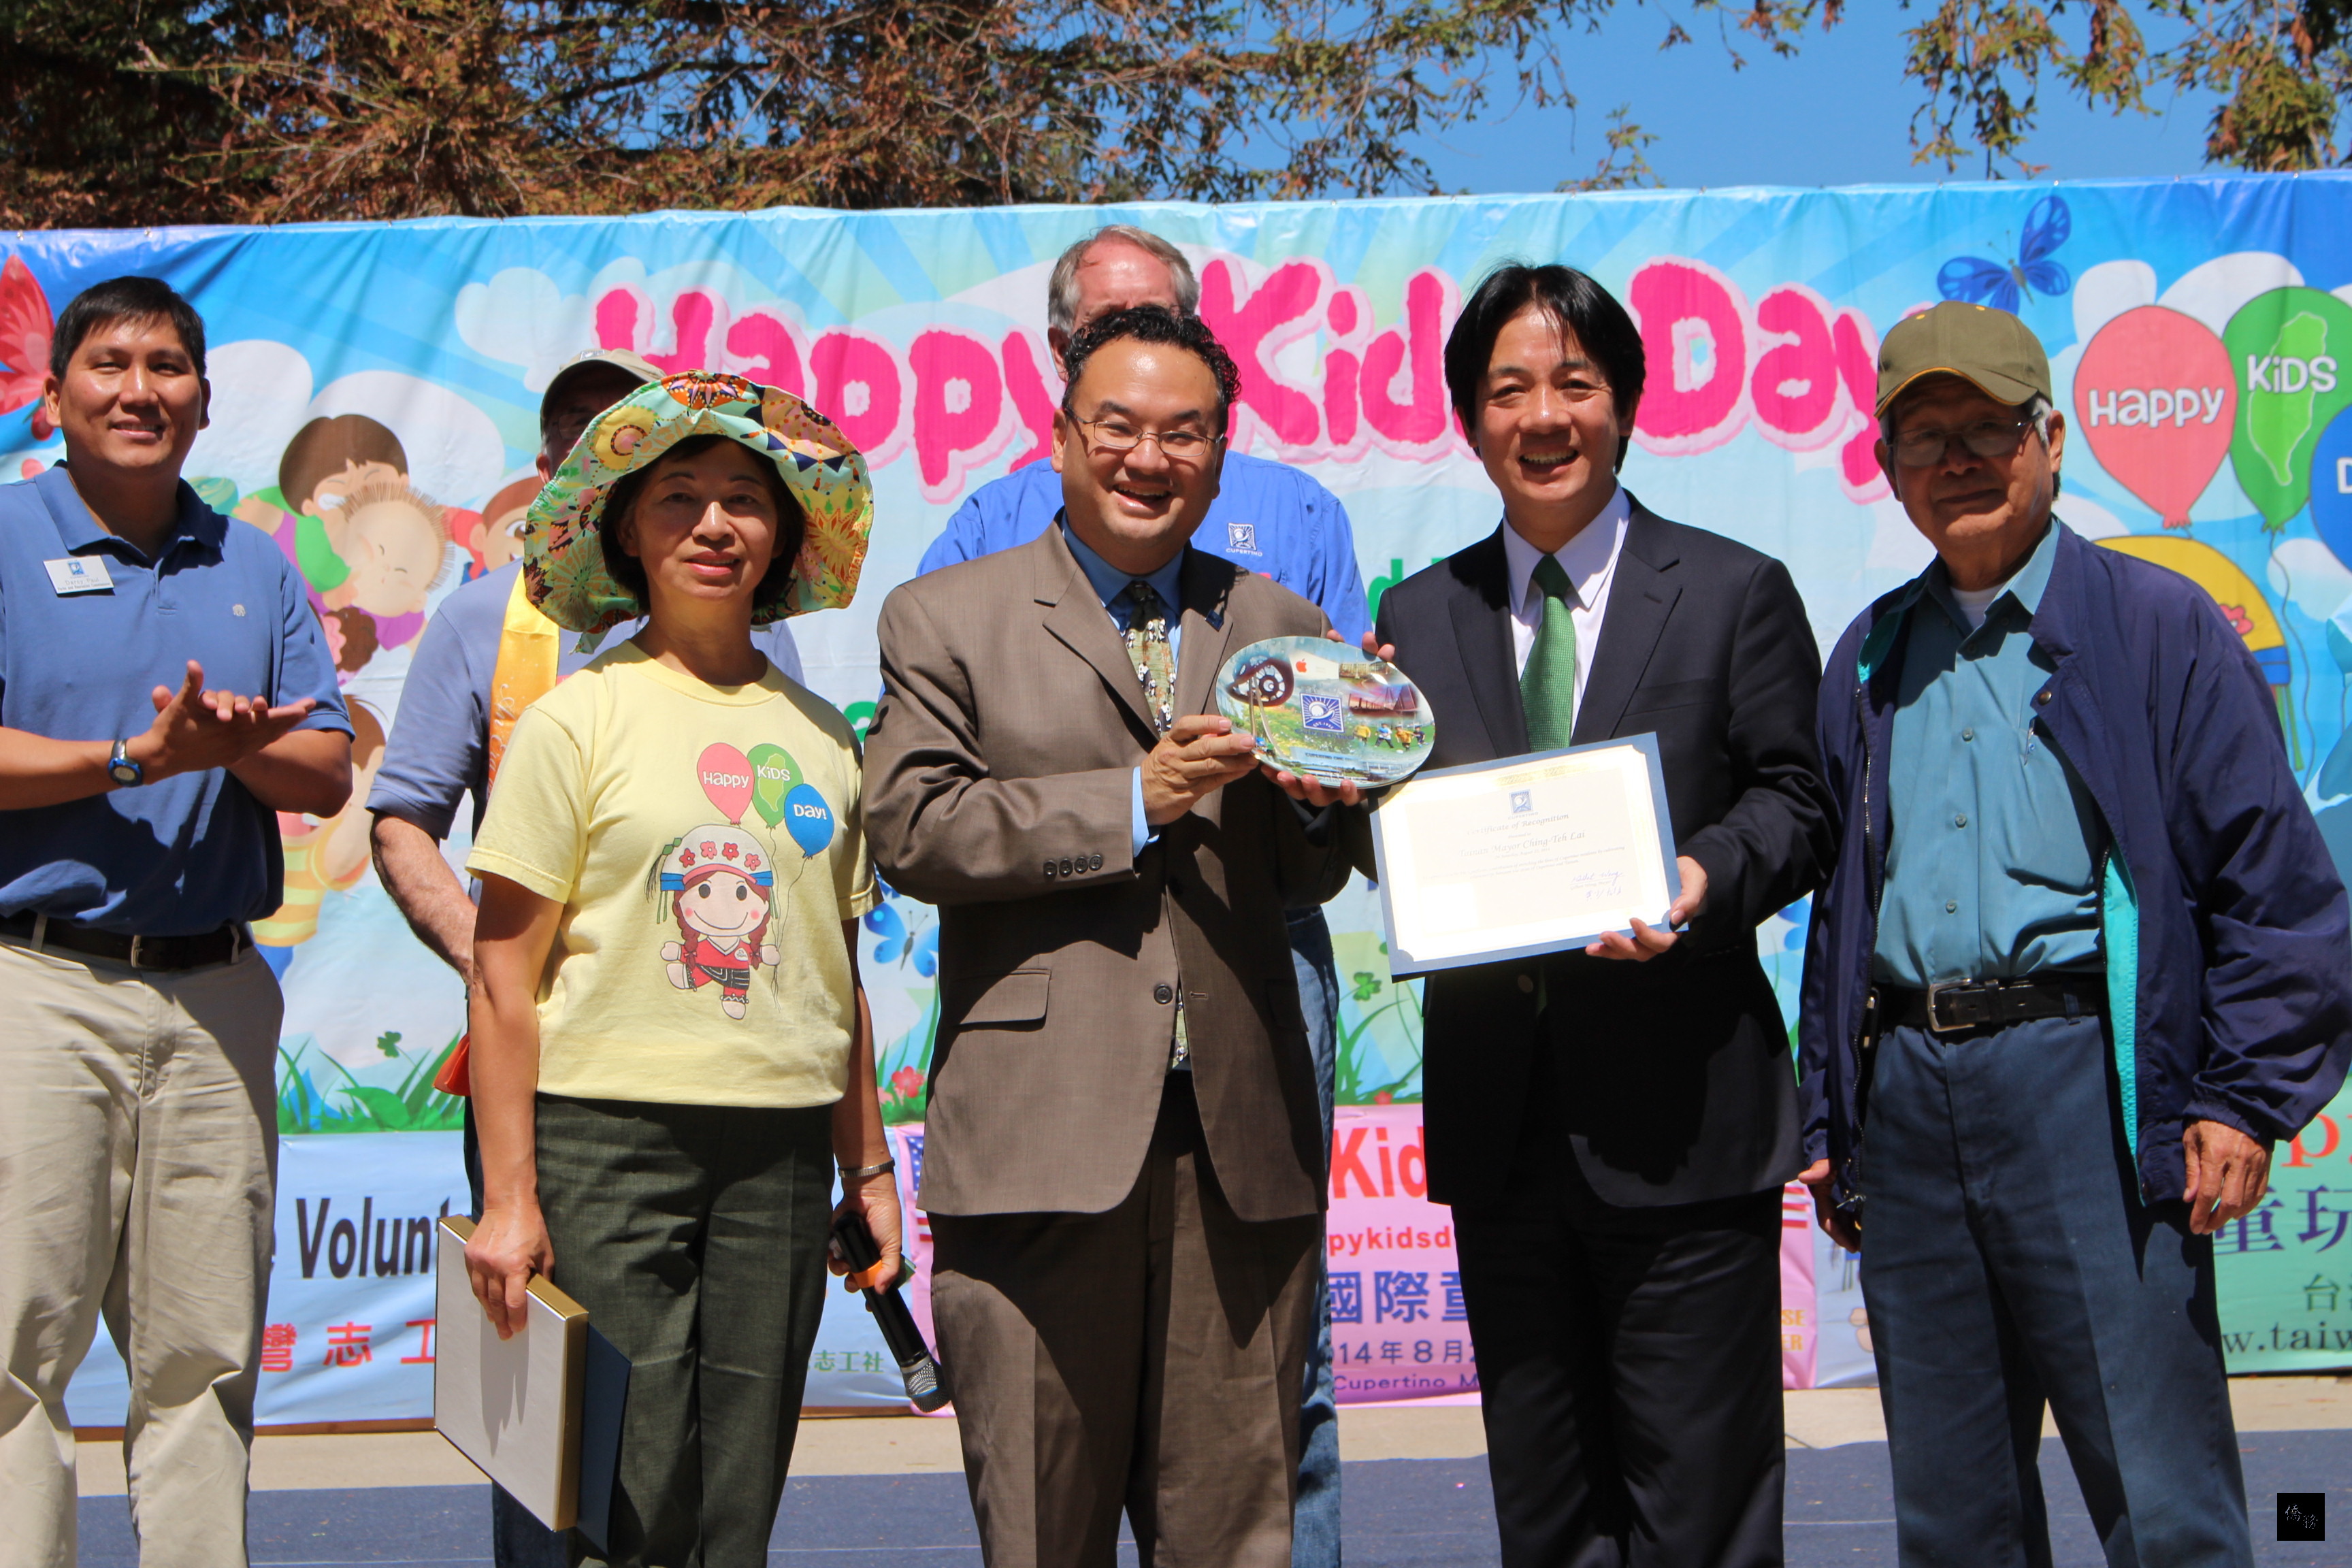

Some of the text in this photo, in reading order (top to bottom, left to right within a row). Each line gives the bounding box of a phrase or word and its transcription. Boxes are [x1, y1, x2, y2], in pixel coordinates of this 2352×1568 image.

[1199, 259, 1467, 446] Kid
[2088, 386, 2225, 429] Happy
[1226, 548, 1263, 557] CUPERTINO
[702, 770, 749, 789] Happy
[793, 803, 828, 821] Day!
[1522, 813, 1569, 828] Recognition
[1491, 843, 1520, 854] Mayor
[1569, 830, 1585, 840] Lai
[808, 1350, 884, 1373] 志工社
[1333, 1373, 1446, 1391] Cupertino
